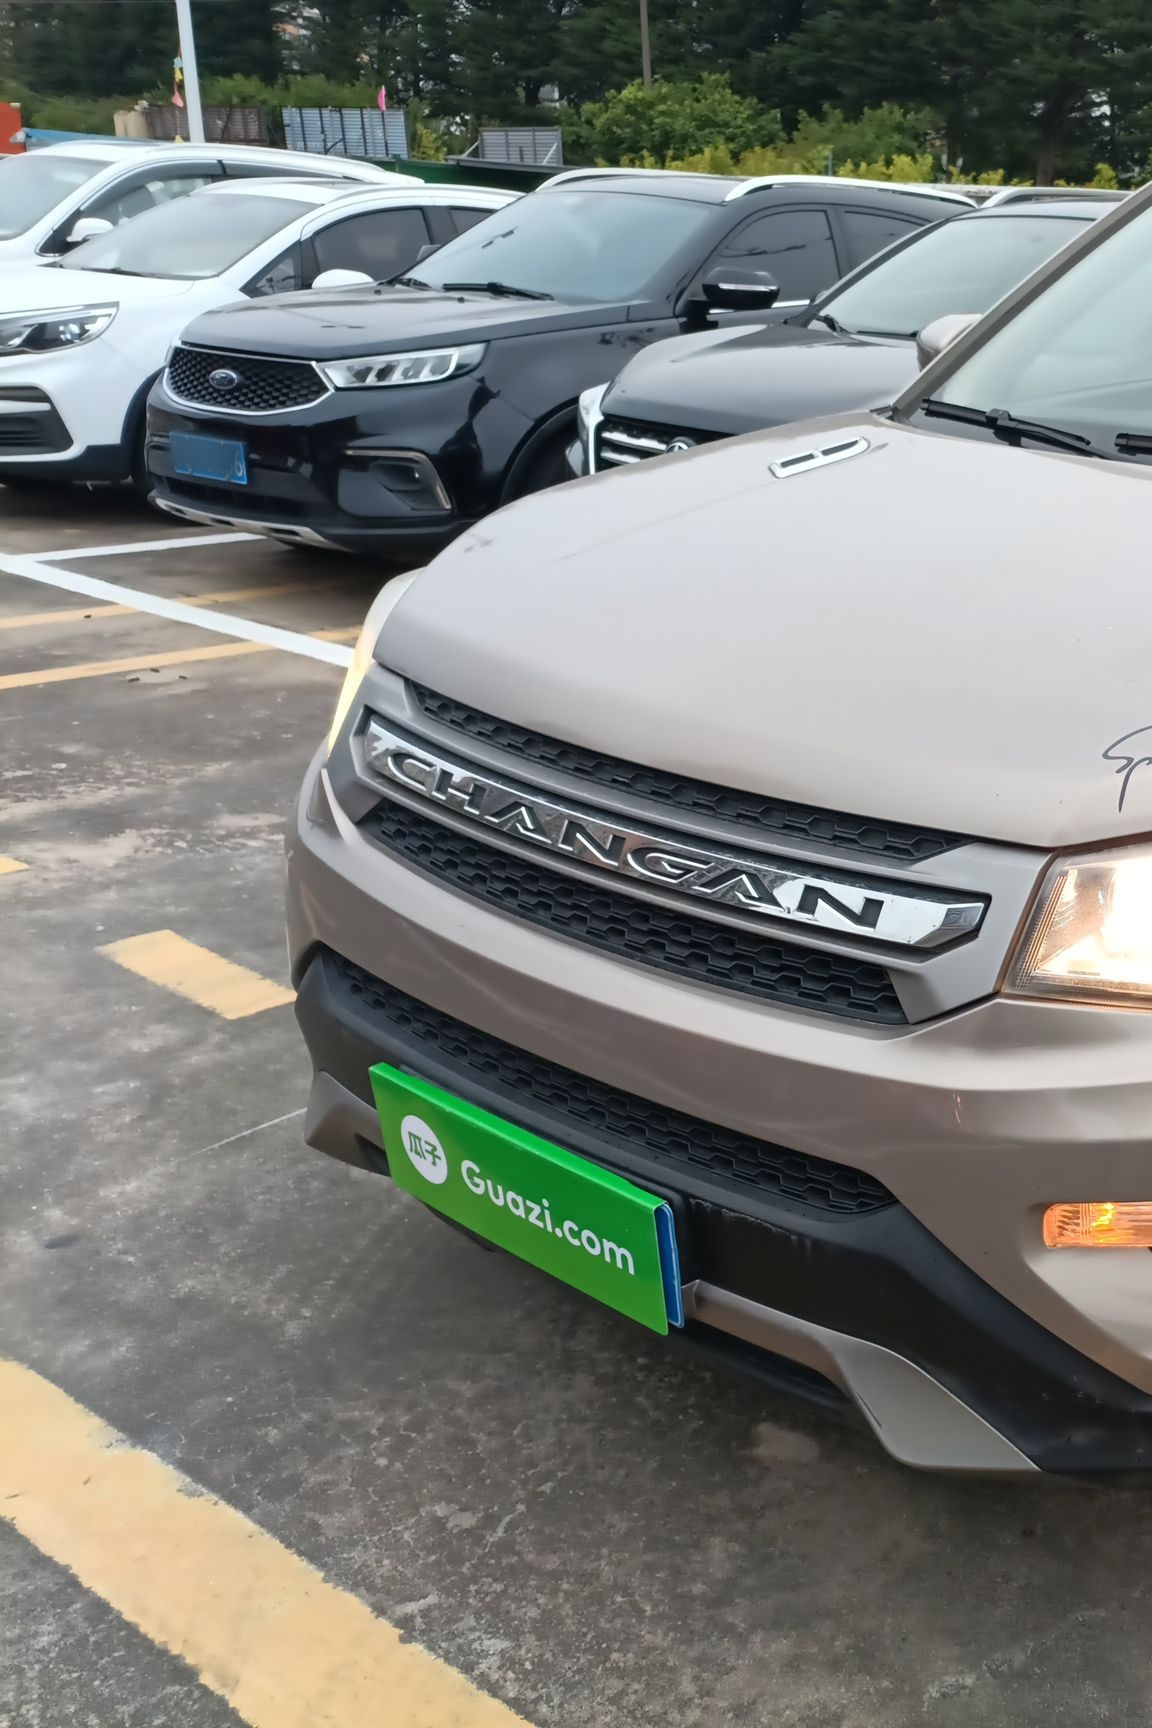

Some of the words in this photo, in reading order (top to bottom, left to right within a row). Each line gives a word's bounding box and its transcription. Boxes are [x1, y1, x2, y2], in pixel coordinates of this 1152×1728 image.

[387, 751, 888, 931] CHANGAN
[407, 1130, 443, 1167] 瓜子
[460, 1159, 636, 1276] Guazi.com
